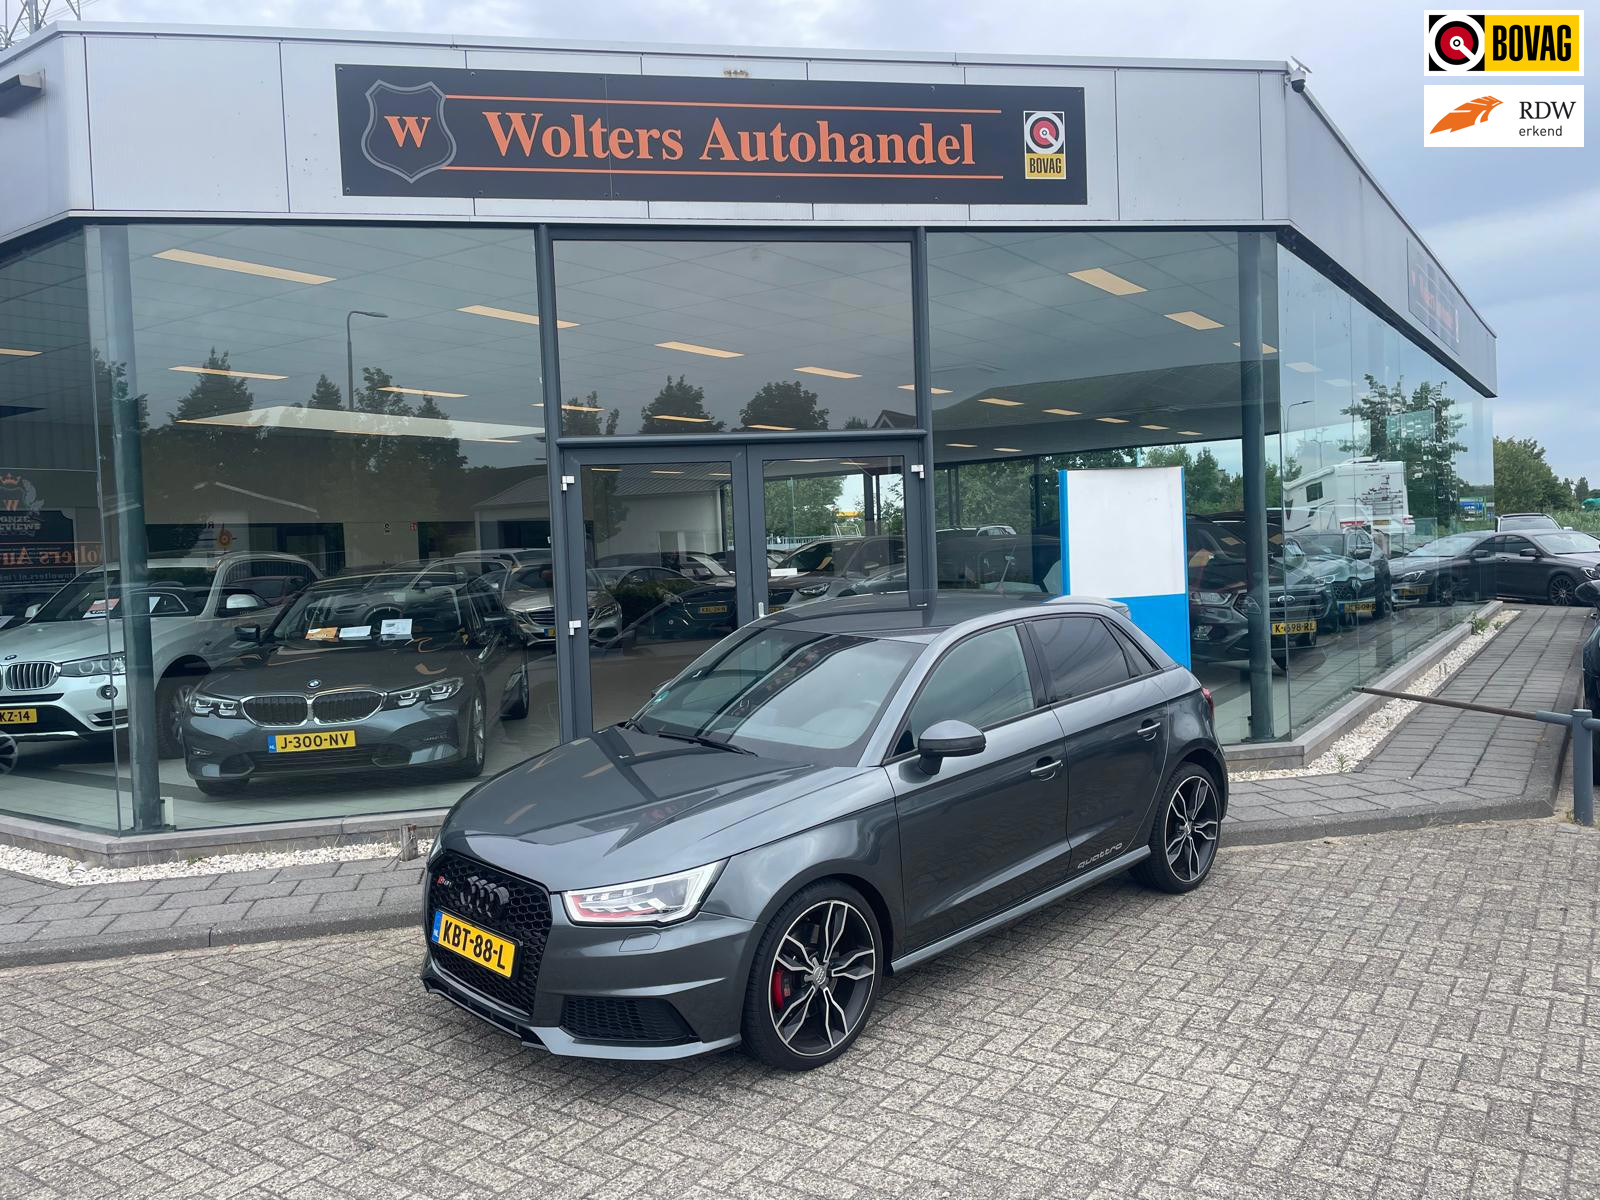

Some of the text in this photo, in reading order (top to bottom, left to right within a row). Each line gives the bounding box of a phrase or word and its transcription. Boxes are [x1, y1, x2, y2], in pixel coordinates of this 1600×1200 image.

[384, 115, 431, 148] W
[482, 111, 976, 165] Wolters Autohandel
[1029, 157, 1063, 175] BOVAG
[280, 733, 349, 750] J-300-NV
[1077, 842, 1123, 869] quattro
[443, 919, 506, 970] KBT-88-L
